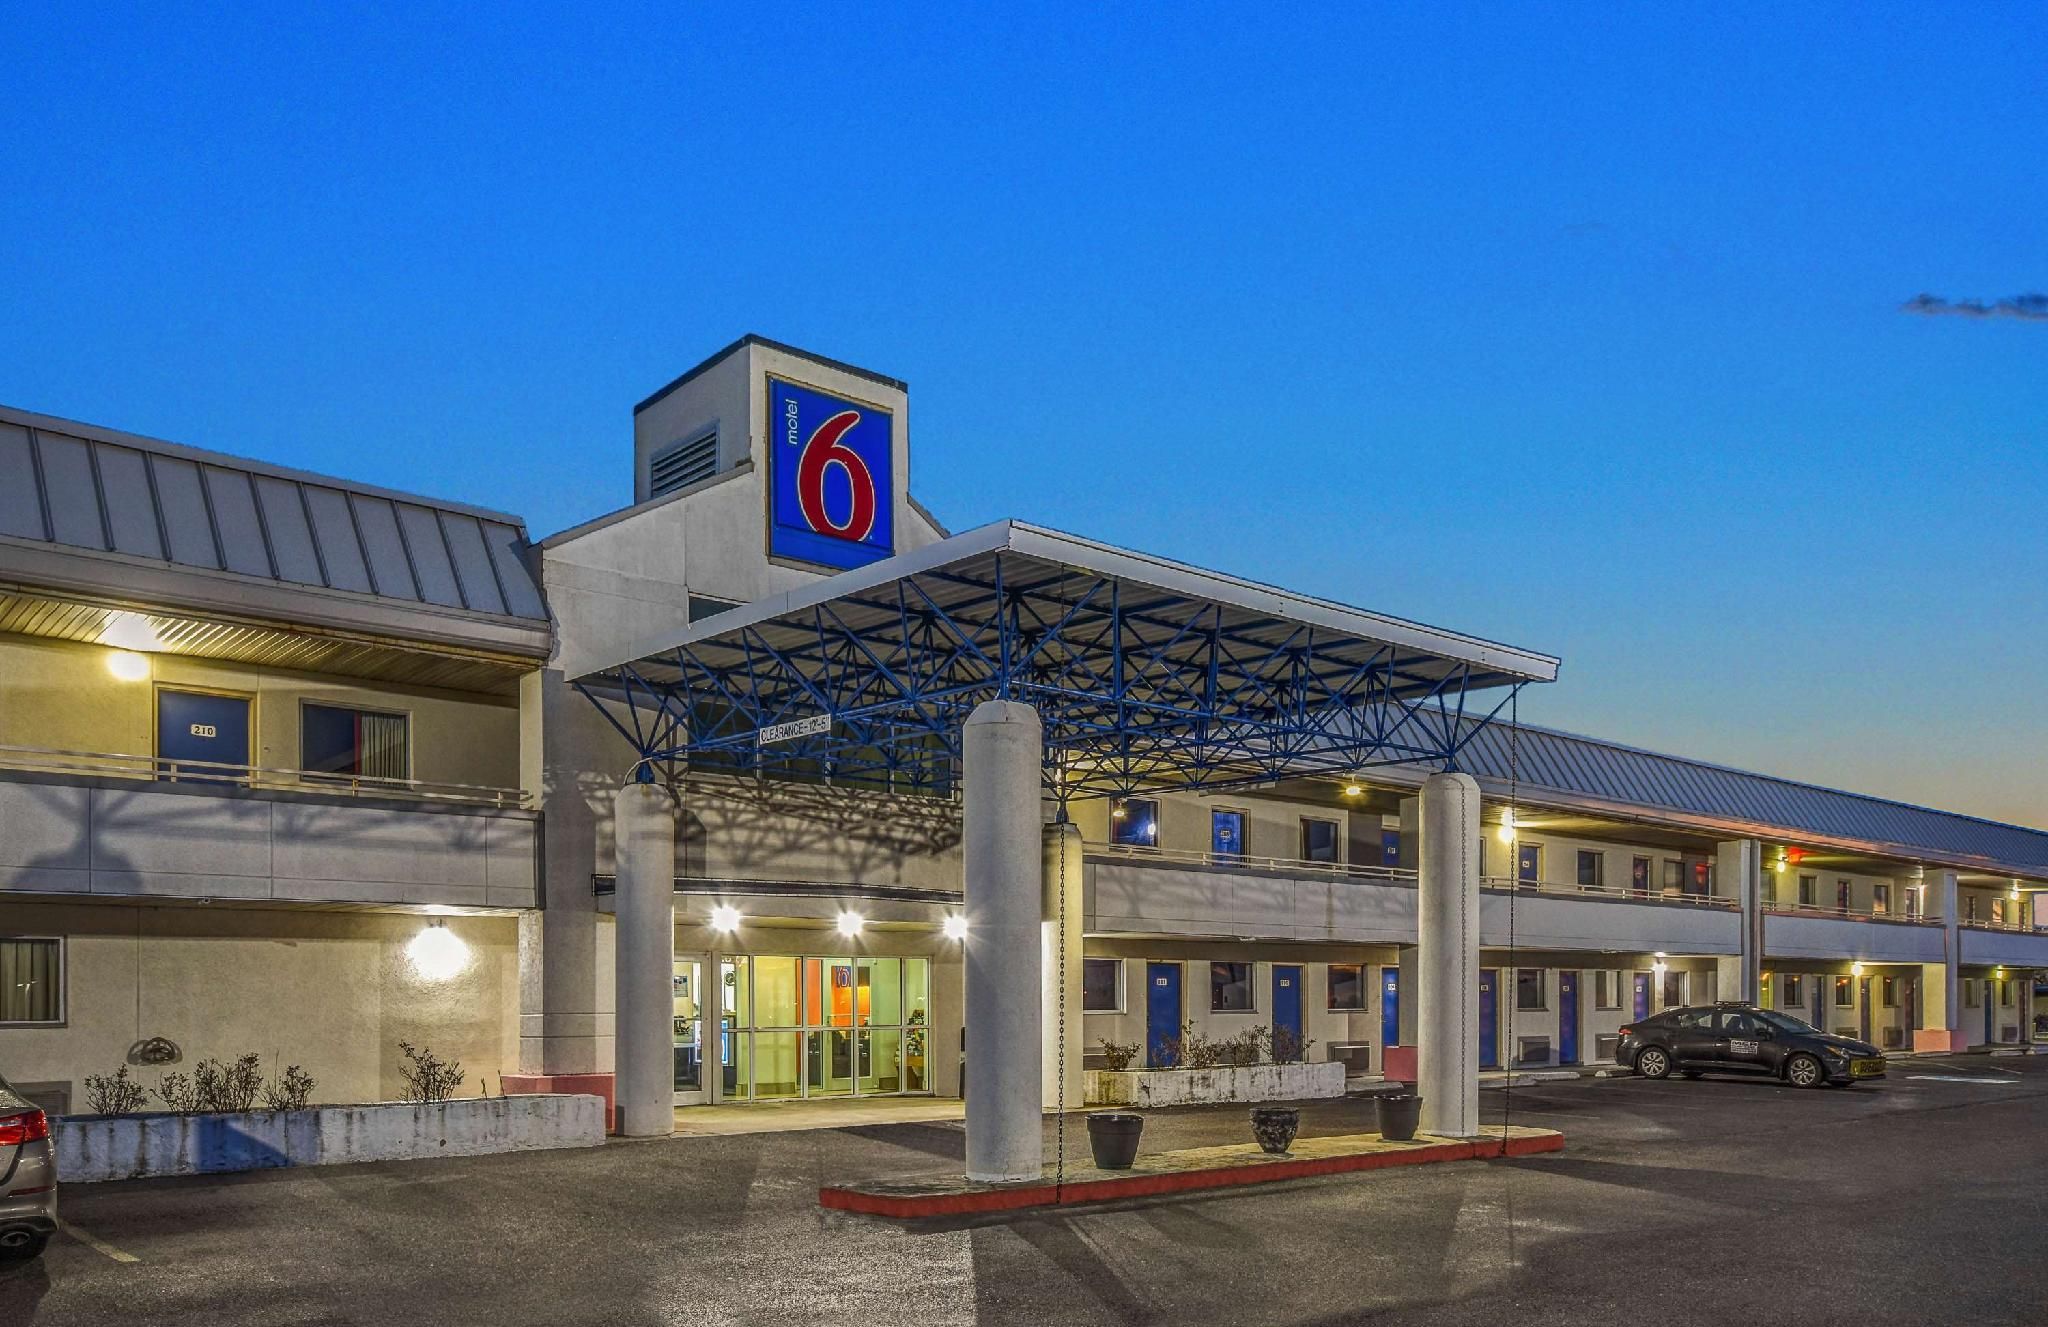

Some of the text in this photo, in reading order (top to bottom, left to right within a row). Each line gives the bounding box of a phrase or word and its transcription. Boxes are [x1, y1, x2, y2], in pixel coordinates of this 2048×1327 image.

[785, 399, 799, 446] motel
[797, 410, 876, 542] 6
[194, 725, 213, 735] 210
